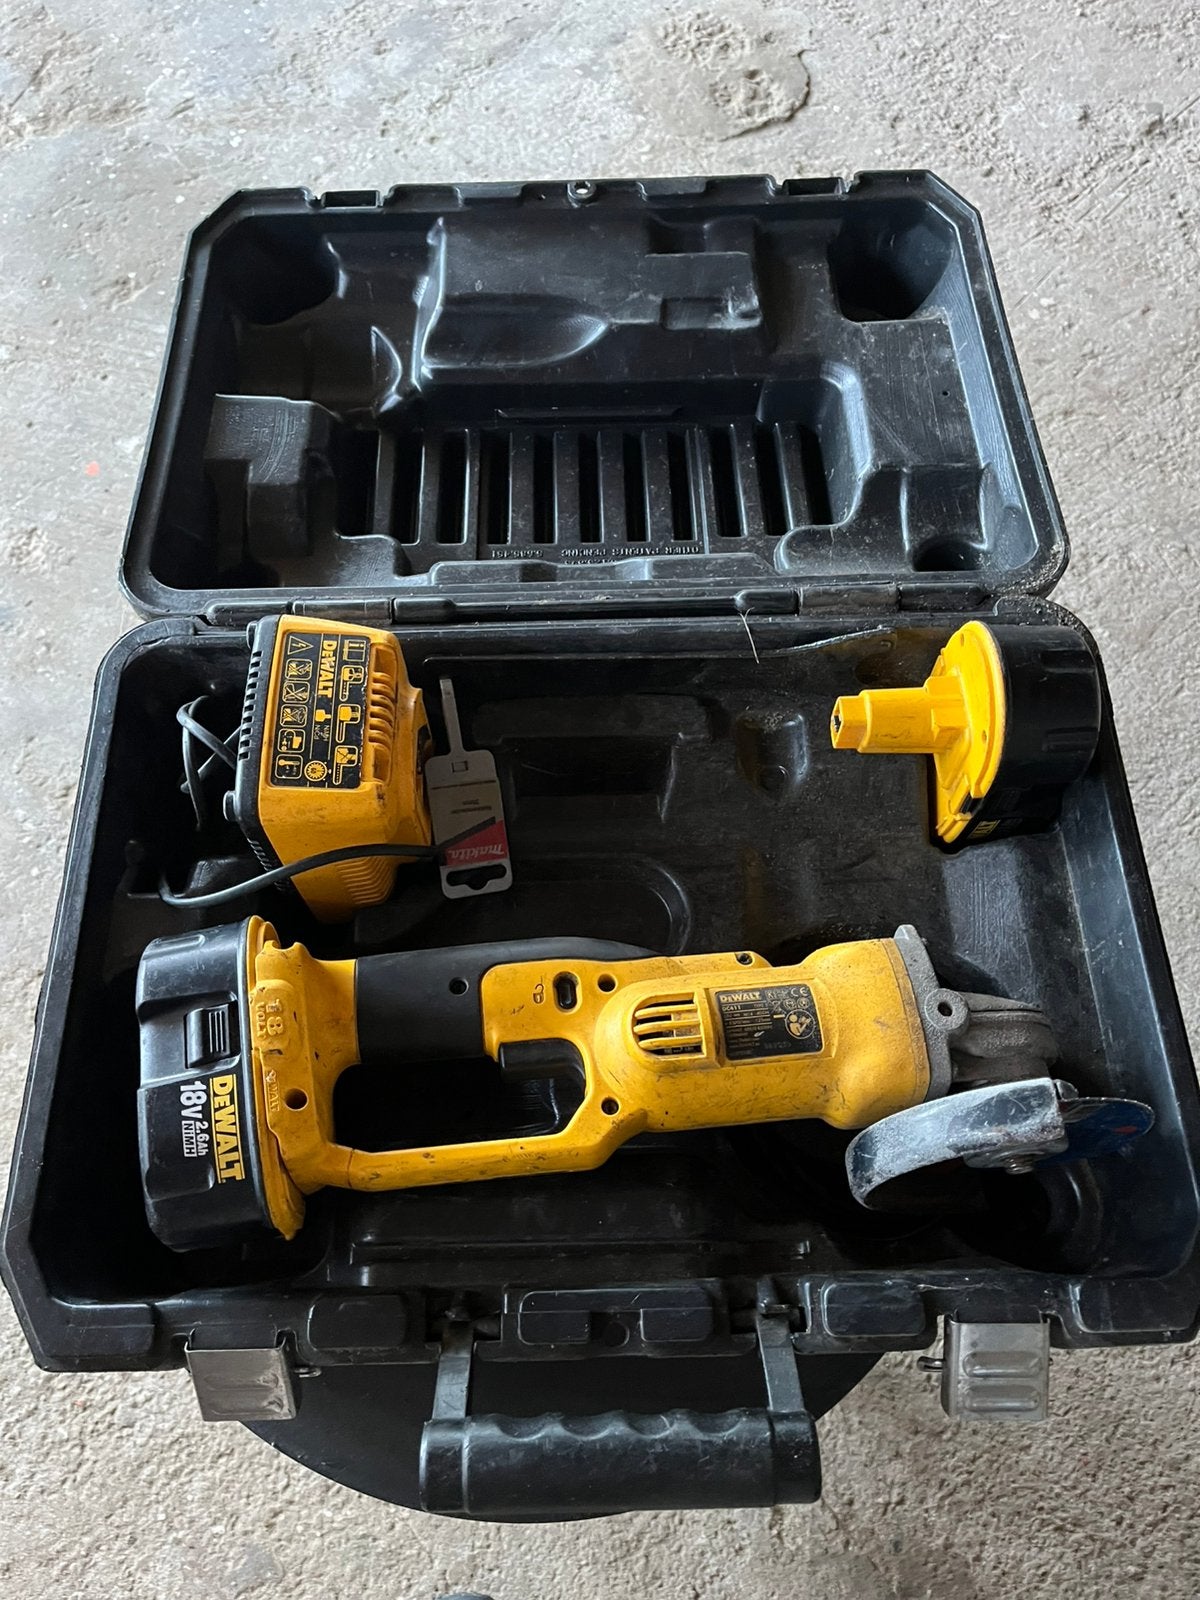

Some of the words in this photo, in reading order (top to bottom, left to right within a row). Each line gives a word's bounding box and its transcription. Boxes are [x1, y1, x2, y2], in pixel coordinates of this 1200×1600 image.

[560, 548, 607, 557] PENDING
[611, 547, 660, 556] PATENTS
[664, 546, 700, 555] OTHER
[184, 1122, 195, 1156] NiMH
